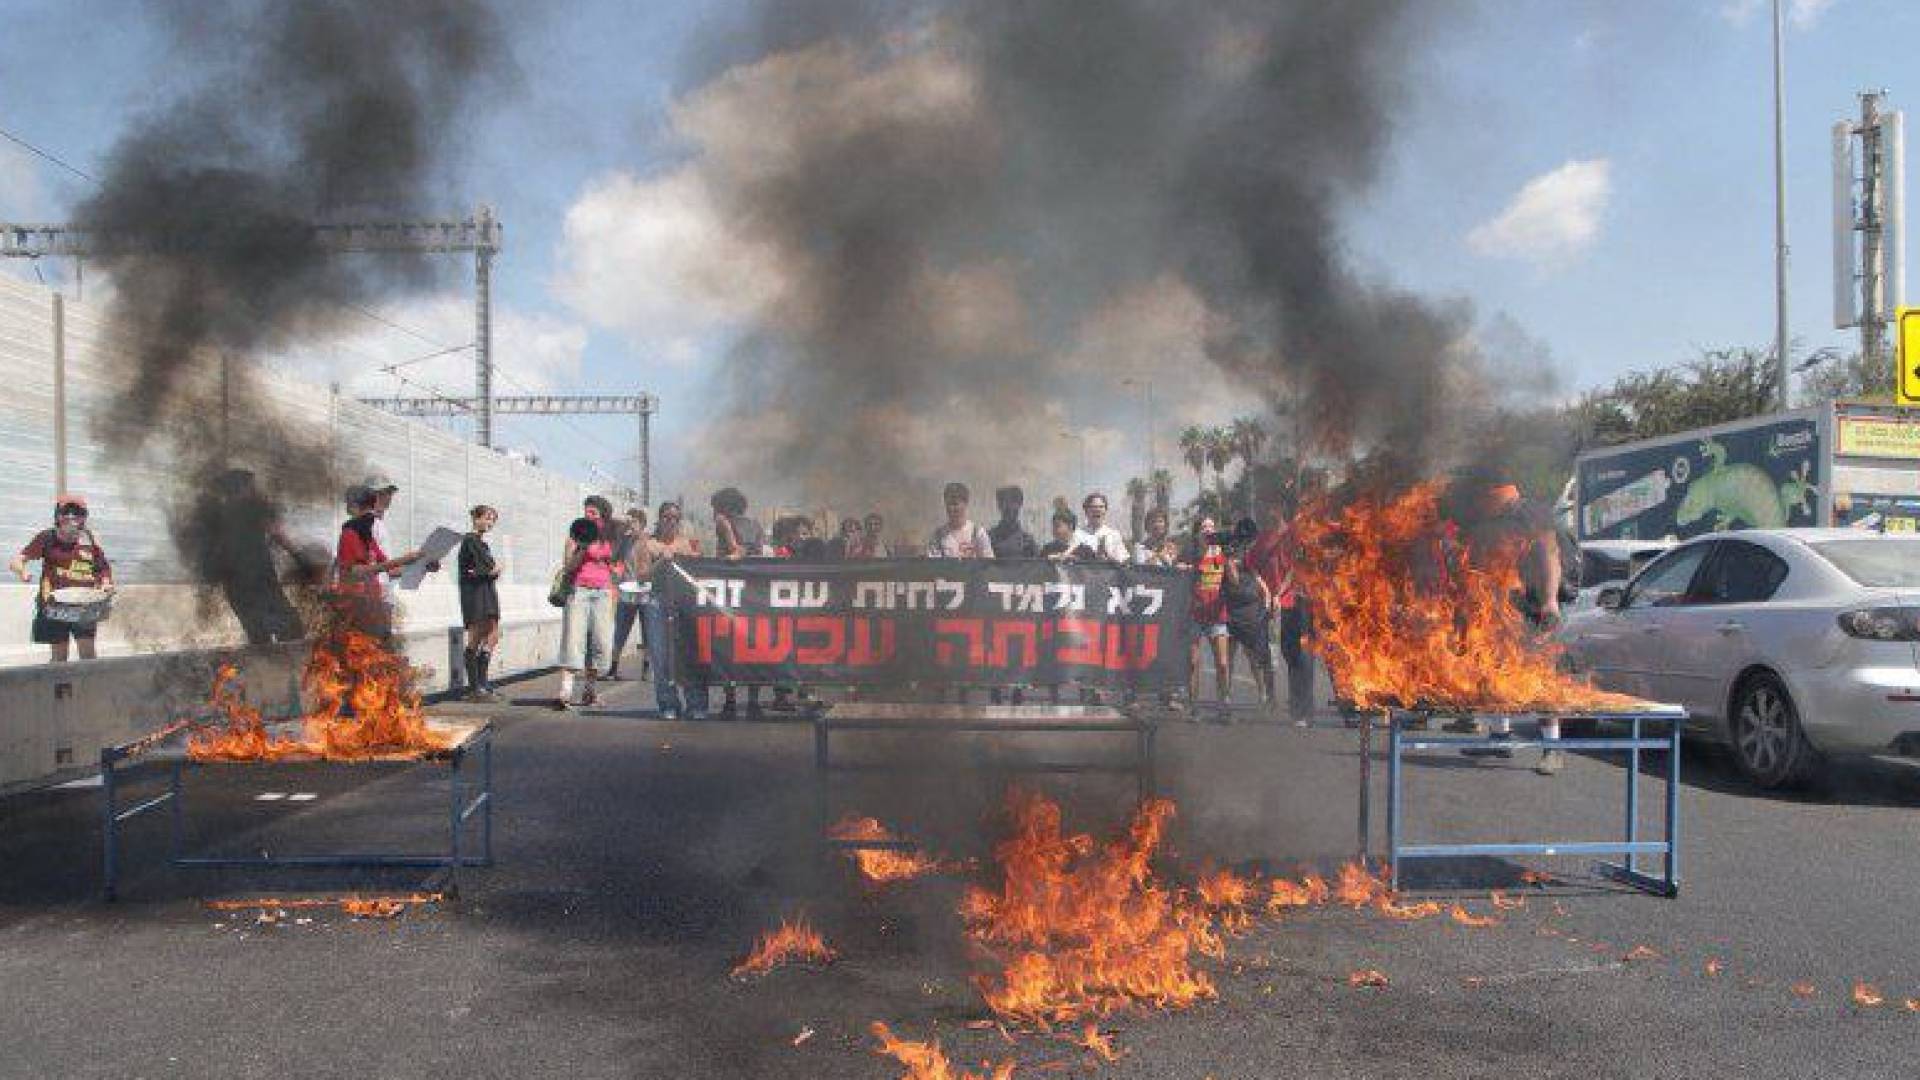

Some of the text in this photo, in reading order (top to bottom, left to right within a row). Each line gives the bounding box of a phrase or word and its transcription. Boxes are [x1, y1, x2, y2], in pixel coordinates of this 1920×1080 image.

[695, 577, 1164, 616] לא נלמד לחיות עם זה
[697, 614, 1160, 671] שביתה עכשיו
